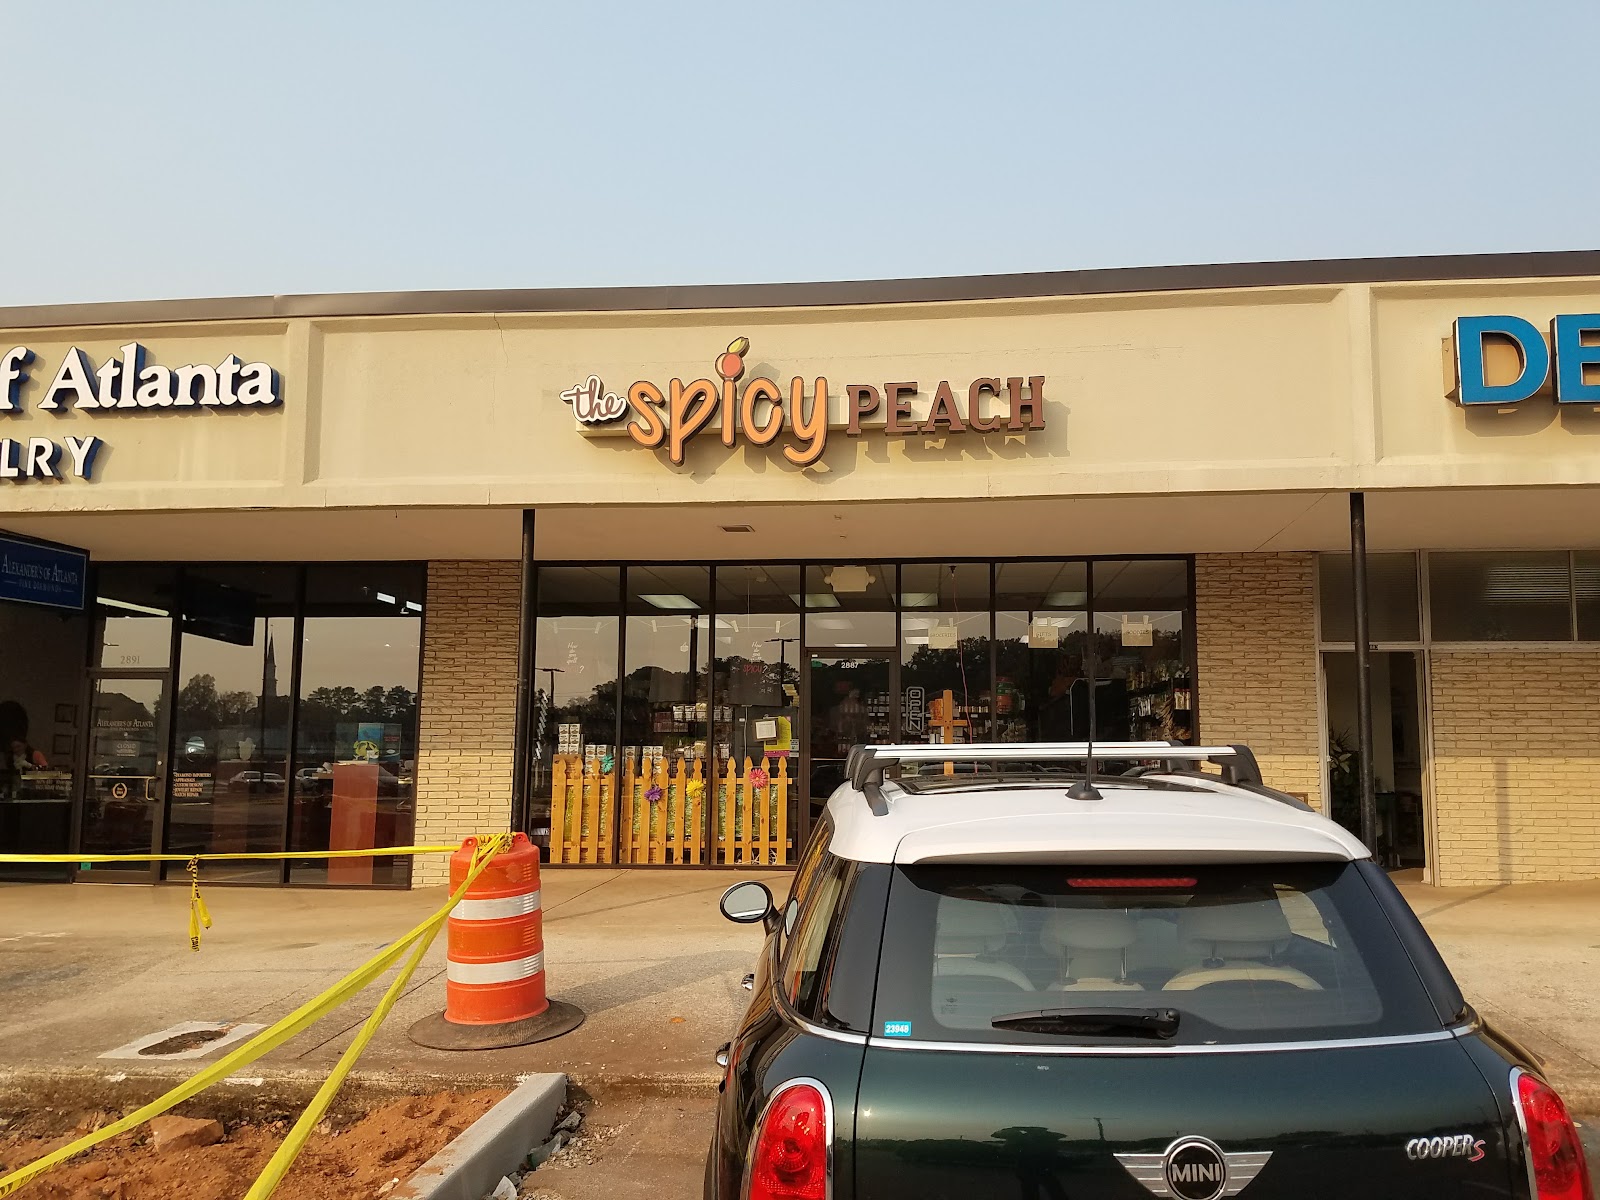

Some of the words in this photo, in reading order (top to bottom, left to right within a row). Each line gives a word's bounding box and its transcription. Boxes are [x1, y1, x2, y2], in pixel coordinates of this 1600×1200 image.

[37, 341, 283, 409] Atlanta
[1453, 313, 1600, 406] DE
[560, 375, 628, 424] the
[845, 375, 1047, 436] PEACH
[0, 436, 103, 482] LRY
[120, 655, 141, 665] 2891
[841, 661, 859, 669] 2887
[909, 689, 921, 732] OPEN
[1406, 1134, 1474, 1161] COOPER
[1171, 1163, 1222, 1182] MINI
